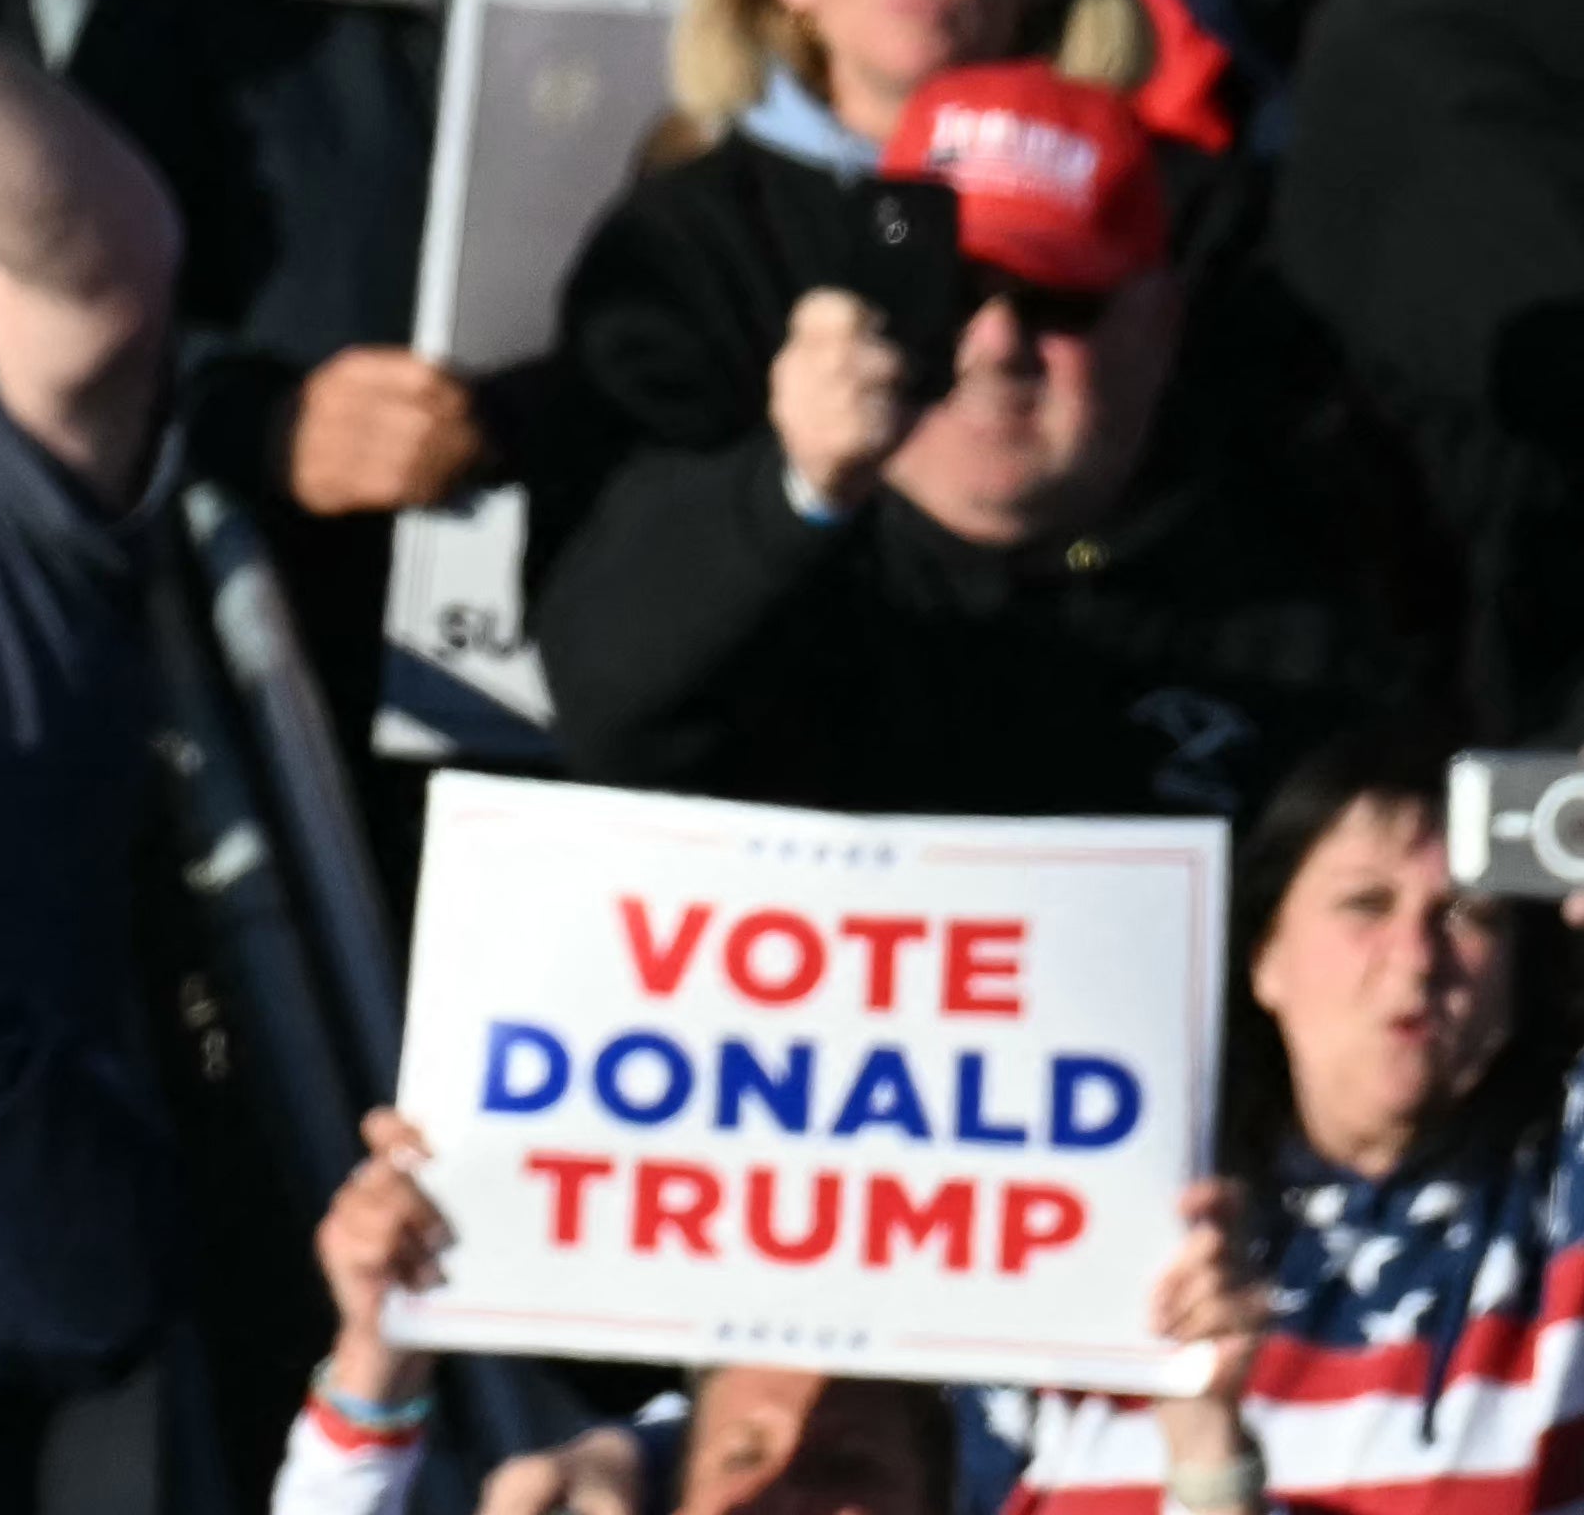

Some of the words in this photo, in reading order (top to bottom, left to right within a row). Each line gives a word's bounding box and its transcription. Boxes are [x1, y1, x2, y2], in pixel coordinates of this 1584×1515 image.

[618, 897, 1028, 1019] VOTE
[478, 1021, 1146, 1155] DONALD
[524, 1150, 1089, 1277] TRUMP
